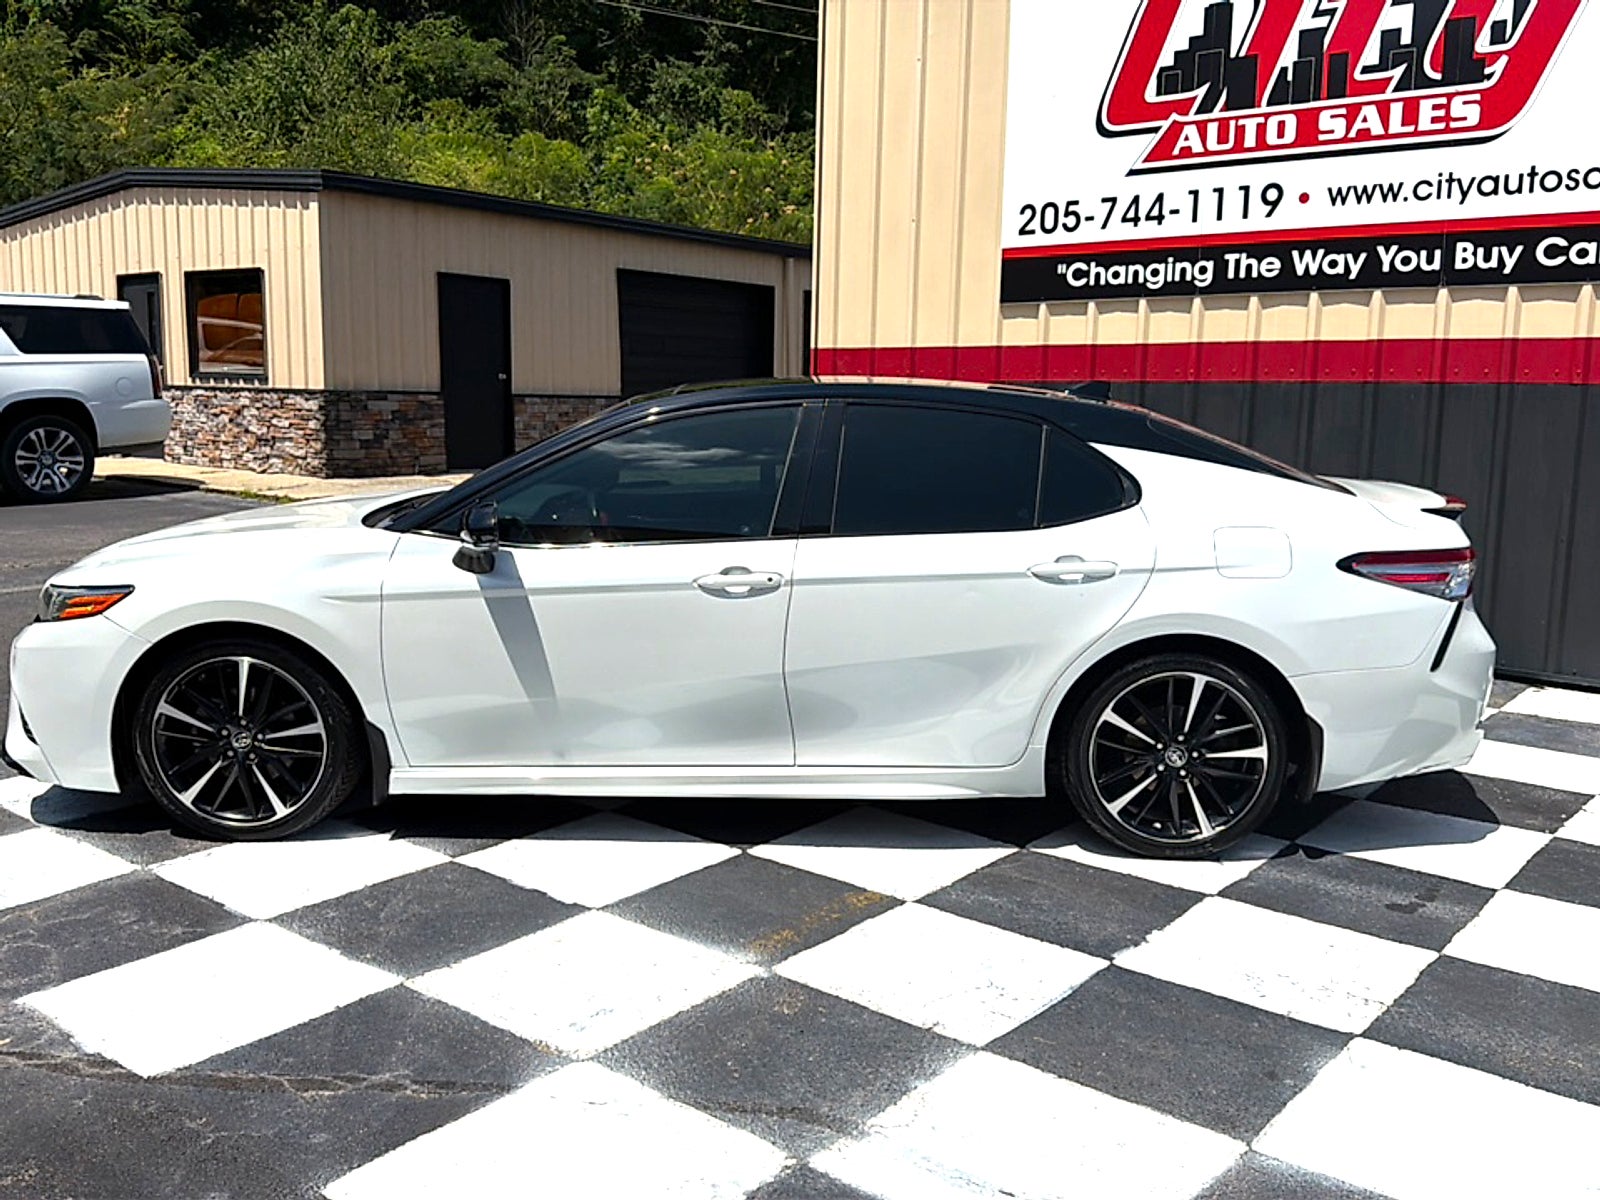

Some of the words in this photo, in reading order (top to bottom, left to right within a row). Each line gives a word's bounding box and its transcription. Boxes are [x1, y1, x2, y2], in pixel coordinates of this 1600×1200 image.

[1171, 113, 1297, 156] AUTO
[1317, 93, 1482, 142] SALES
[1018, 182, 1284, 236] 205-744-1119
[1223, 252, 1282, 280] The
[1291, 248, 1367, 279] Way
[1376, 245, 1442, 273] You
[1454, 241, 1524, 275] Buy
[1535, 236, 1600, 267] Ca
